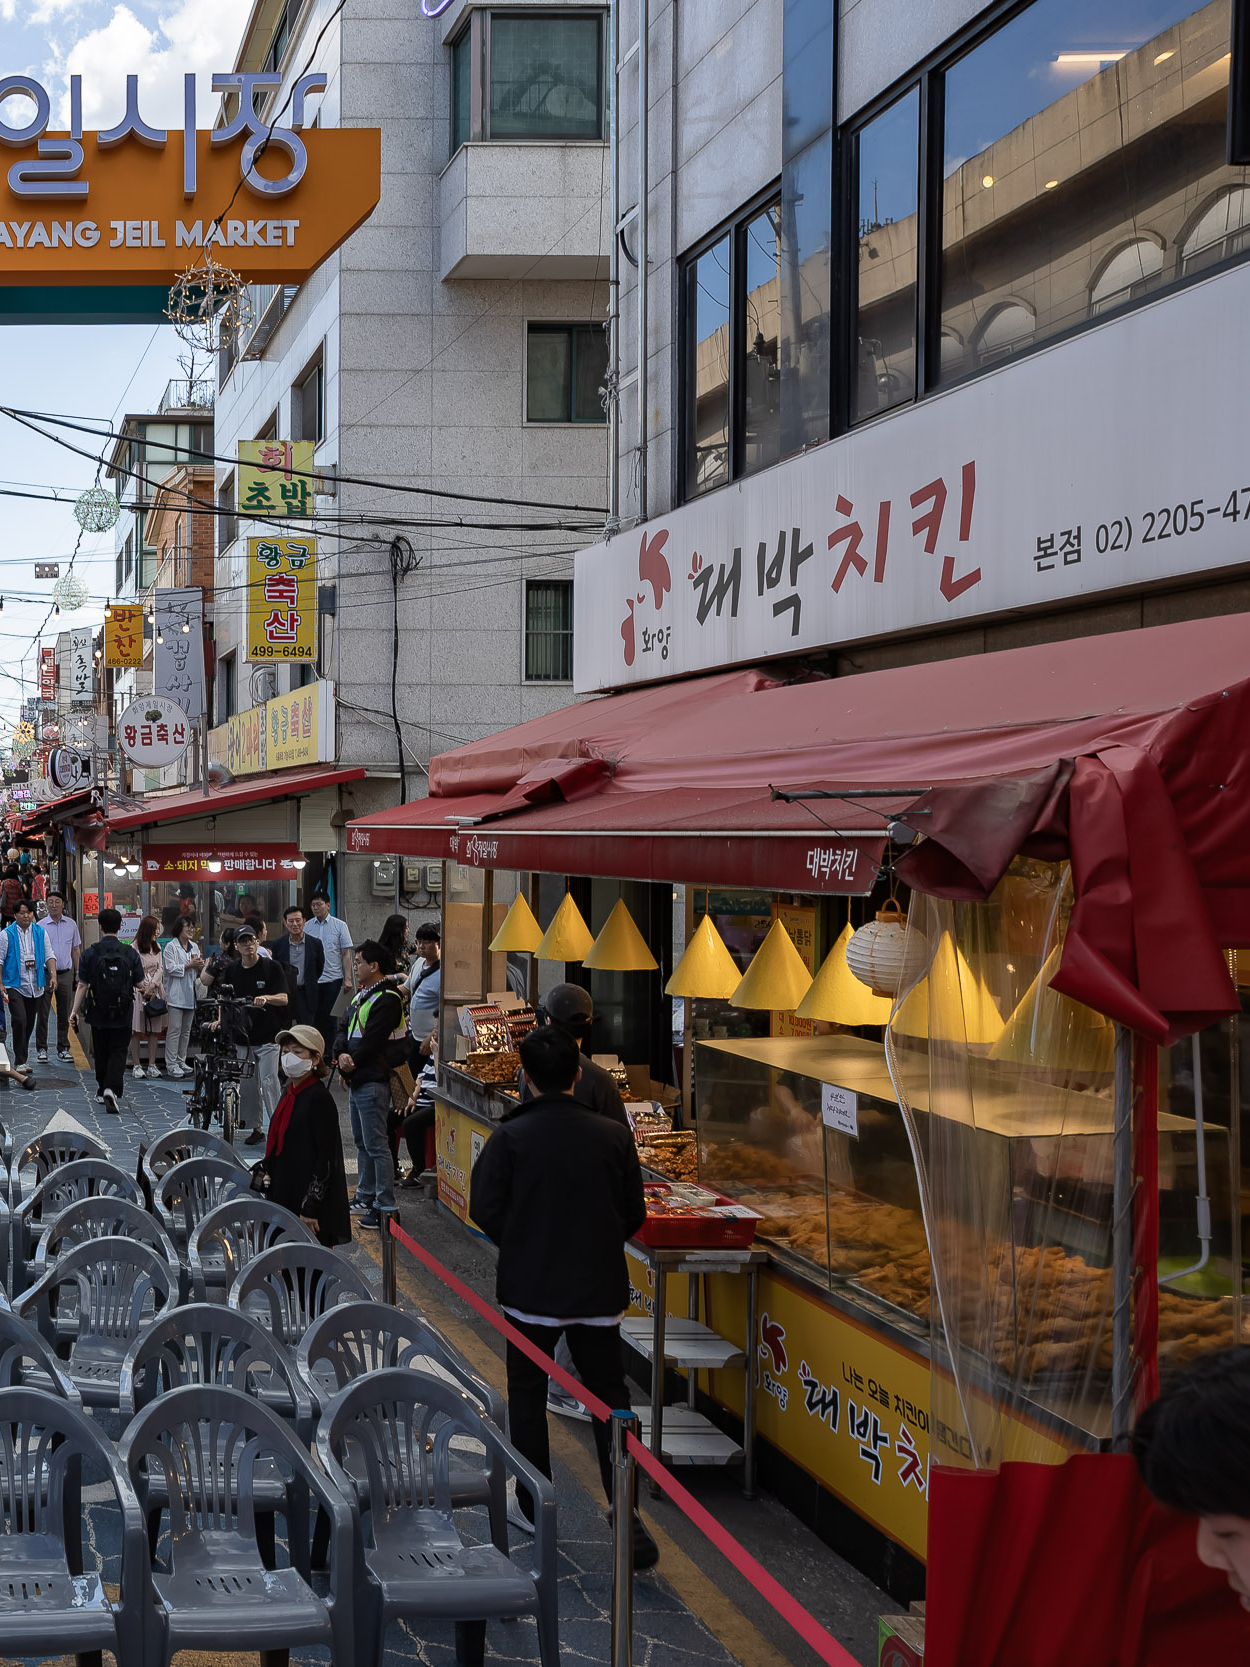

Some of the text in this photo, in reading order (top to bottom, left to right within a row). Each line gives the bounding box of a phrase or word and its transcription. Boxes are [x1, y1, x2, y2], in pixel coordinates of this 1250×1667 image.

[109, 219, 166, 249] JEIL
[175, 219, 300, 250] MARKET
[241, 478, 312, 516] 초밥
[256, 541, 311, 569] 황금
[1034, 525, 1084, 573] 본점
[1095, 515, 1132, 557] 02)
[112, 608, 136, 658] 반찬
[640, 625, 672, 661] 화양
[251, 646, 312, 657] 499-6494
[124, 723, 186, 748] 황금축산
[163, 859, 198, 871] 소·돼지
[223, 859, 276, 871] 판매합니다
[806, 846, 858, 881] 대박치킨
[763, 1370, 789, 1412] 화양
[841, 1361, 865, 1393] 나는
[867, 1377, 891, 1409] 오늘
